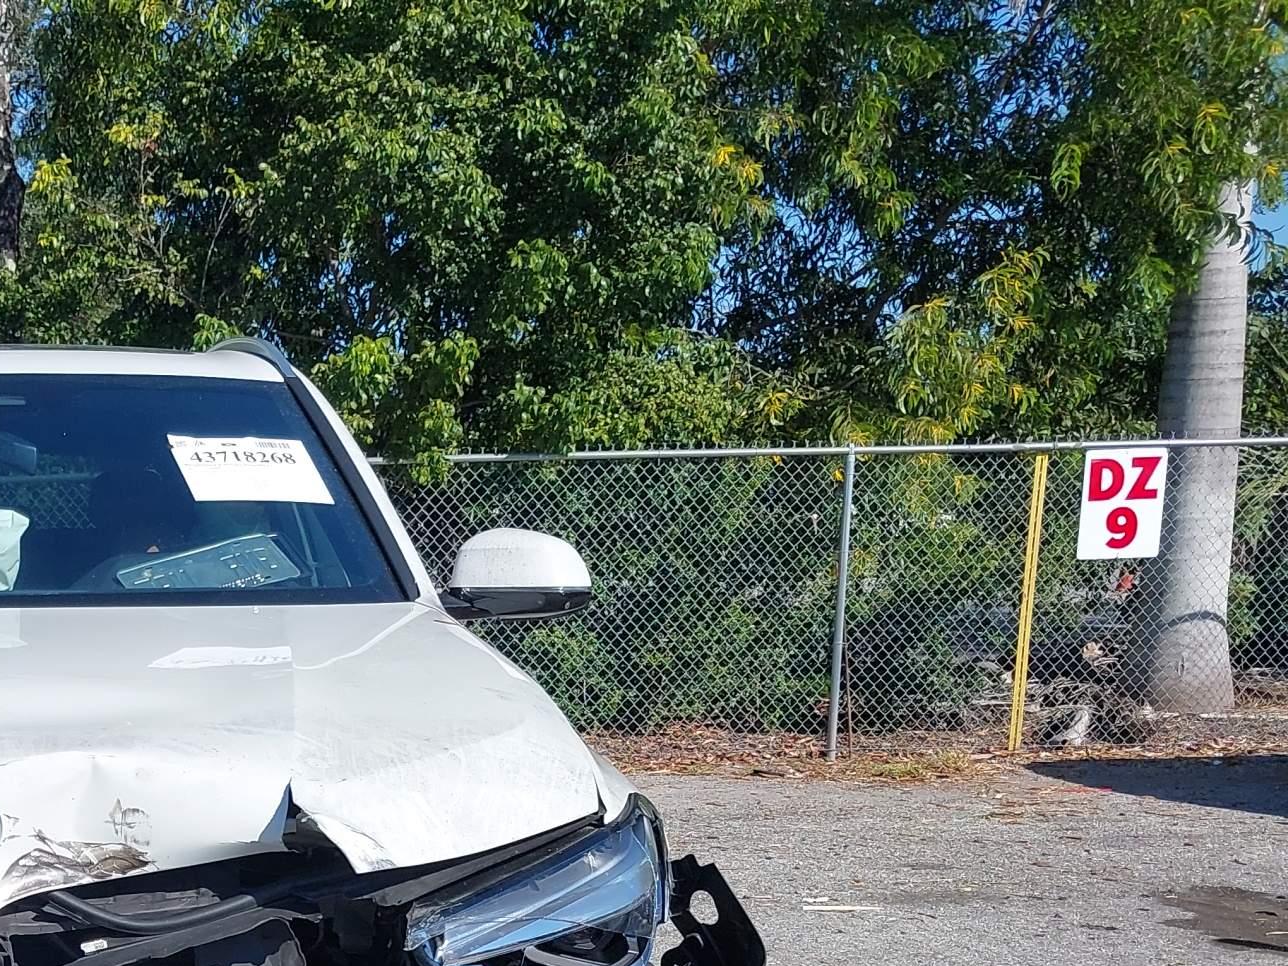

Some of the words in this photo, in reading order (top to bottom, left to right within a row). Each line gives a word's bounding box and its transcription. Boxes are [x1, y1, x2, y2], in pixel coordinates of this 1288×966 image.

[190, 450, 297, 465] 43718268
[1087, 456, 1162, 502] DZ
[1105, 506, 1139, 550] 9
